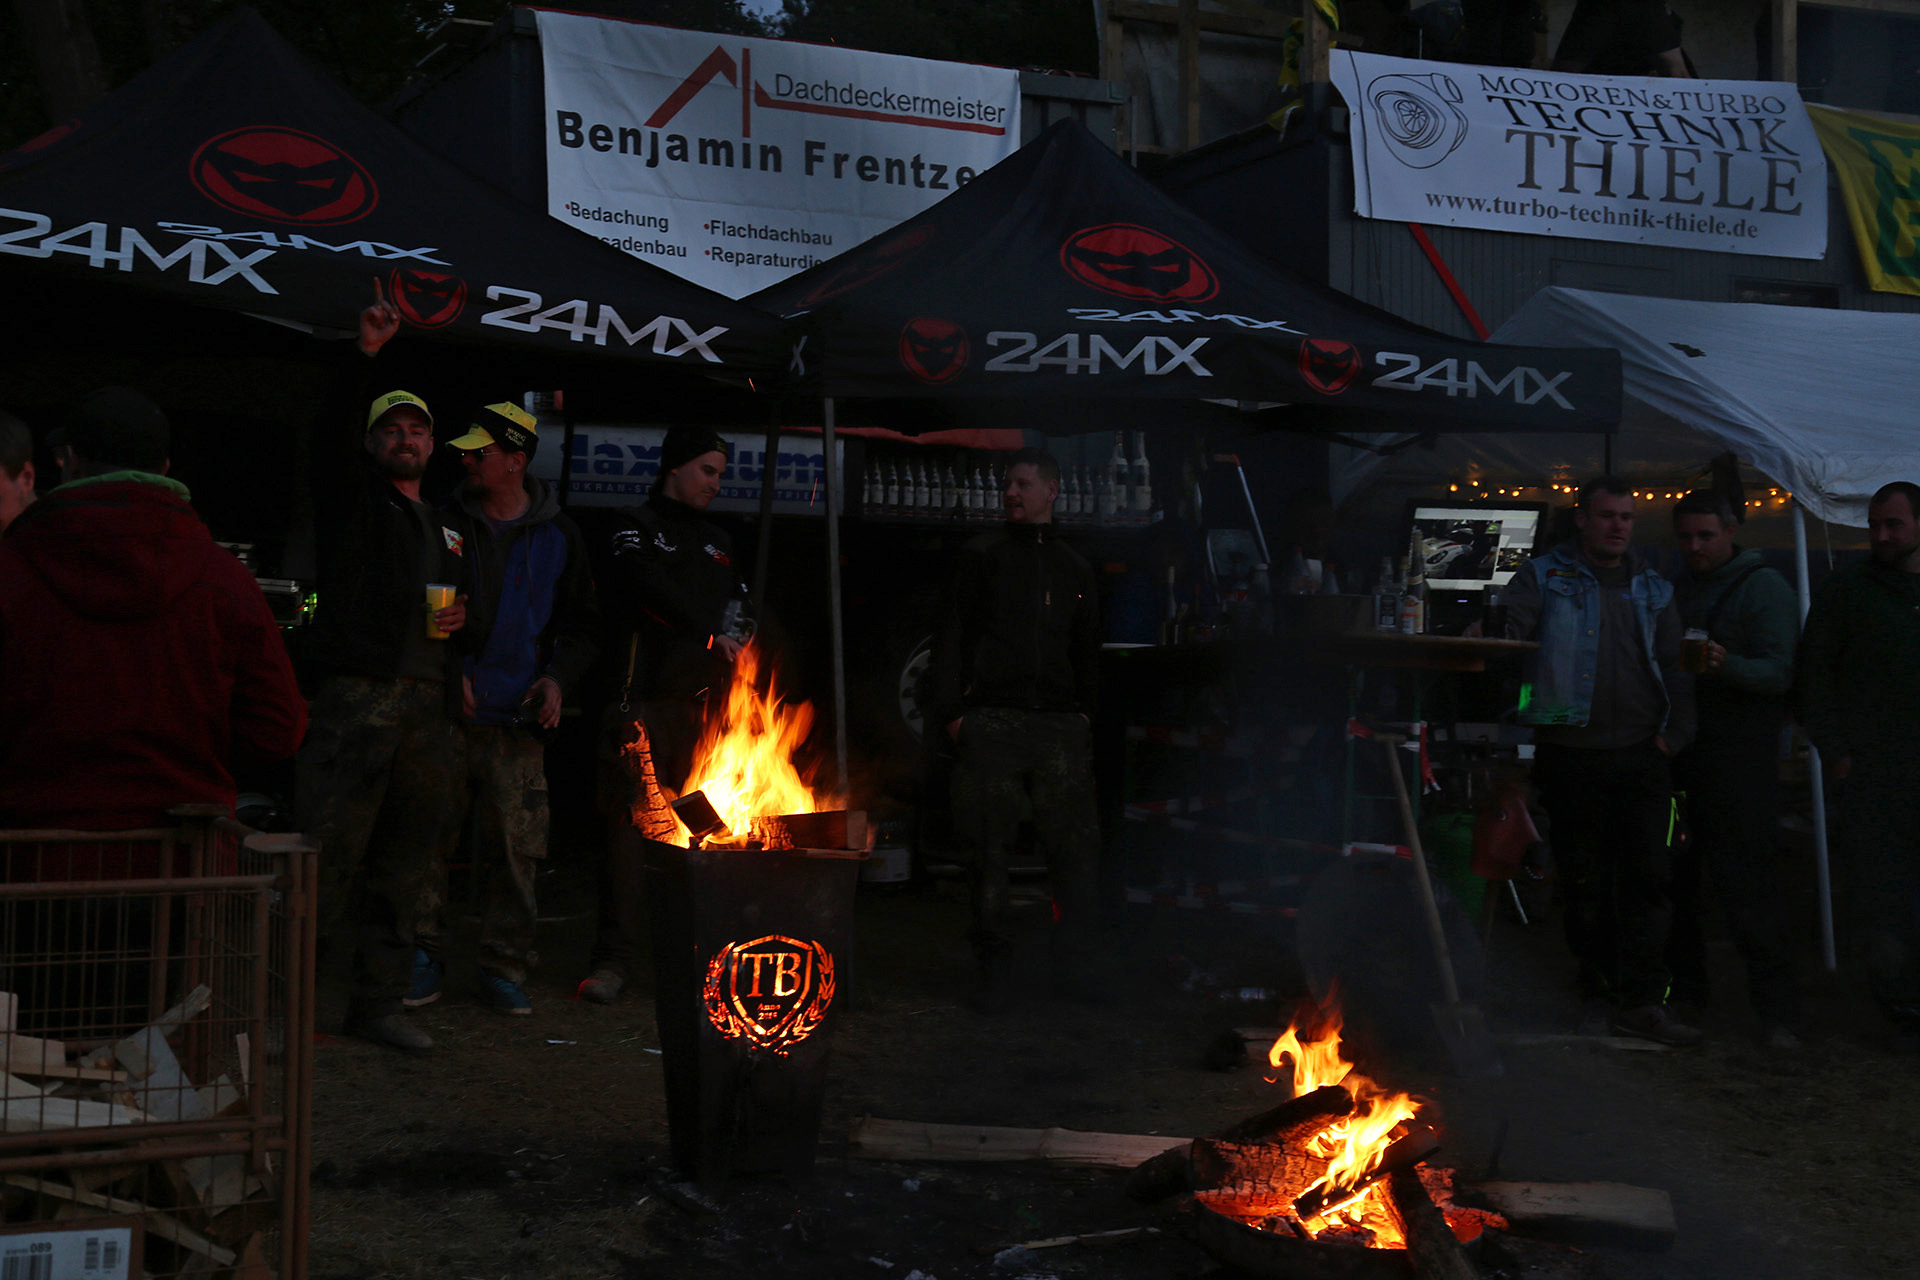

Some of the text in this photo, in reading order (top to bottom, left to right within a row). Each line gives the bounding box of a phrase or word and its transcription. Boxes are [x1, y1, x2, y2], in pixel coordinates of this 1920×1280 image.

[775, 74, 1006, 124] Dachdeckermeister
[1478, 73, 1786, 115] MOTOREN&TURBO
[1487, 95, 1801, 156] TECHNIK
[557, 110, 990, 191] Benjamin Frentze
[1505, 128, 1803, 216] THIELE
[570, 201, 669, 233] Bedachung
[710, 220, 832, 246] Flachdachbau
[1426, 192, 1758, 240] www.turbo-technik-thiele.de
[0, 207, 280, 295] 24MX
[156, 221, 454, 266] 24MX
[480, 285, 730, 364] 24MX
[1066, 307, 1309, 335] 24MX
[985, 331, 1214, 376] 24MX
[1371, 351, 1576, 411] 24MX
[741, 952, 801, 998] TB
